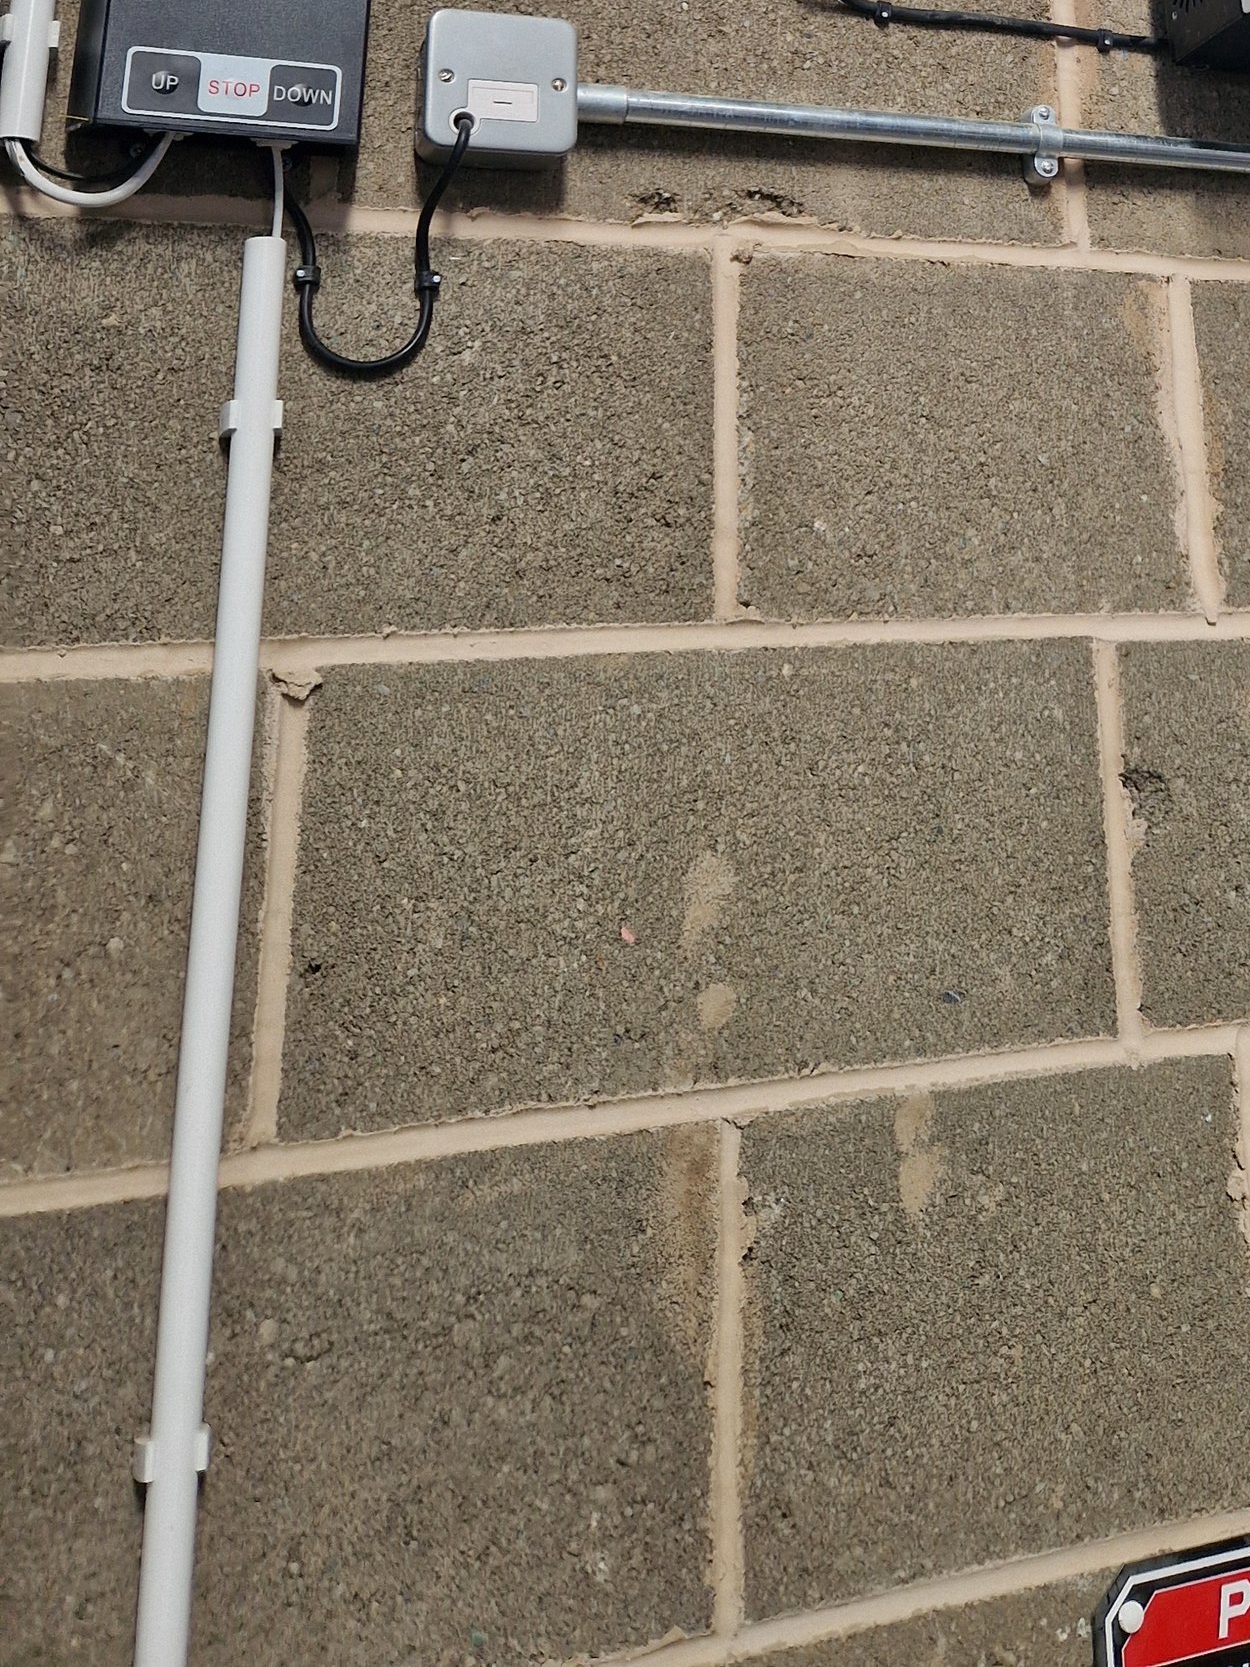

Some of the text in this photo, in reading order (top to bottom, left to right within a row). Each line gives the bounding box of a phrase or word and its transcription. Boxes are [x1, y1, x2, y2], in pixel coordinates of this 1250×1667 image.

[151, 73, 333, 105] UP STOP DOWN
